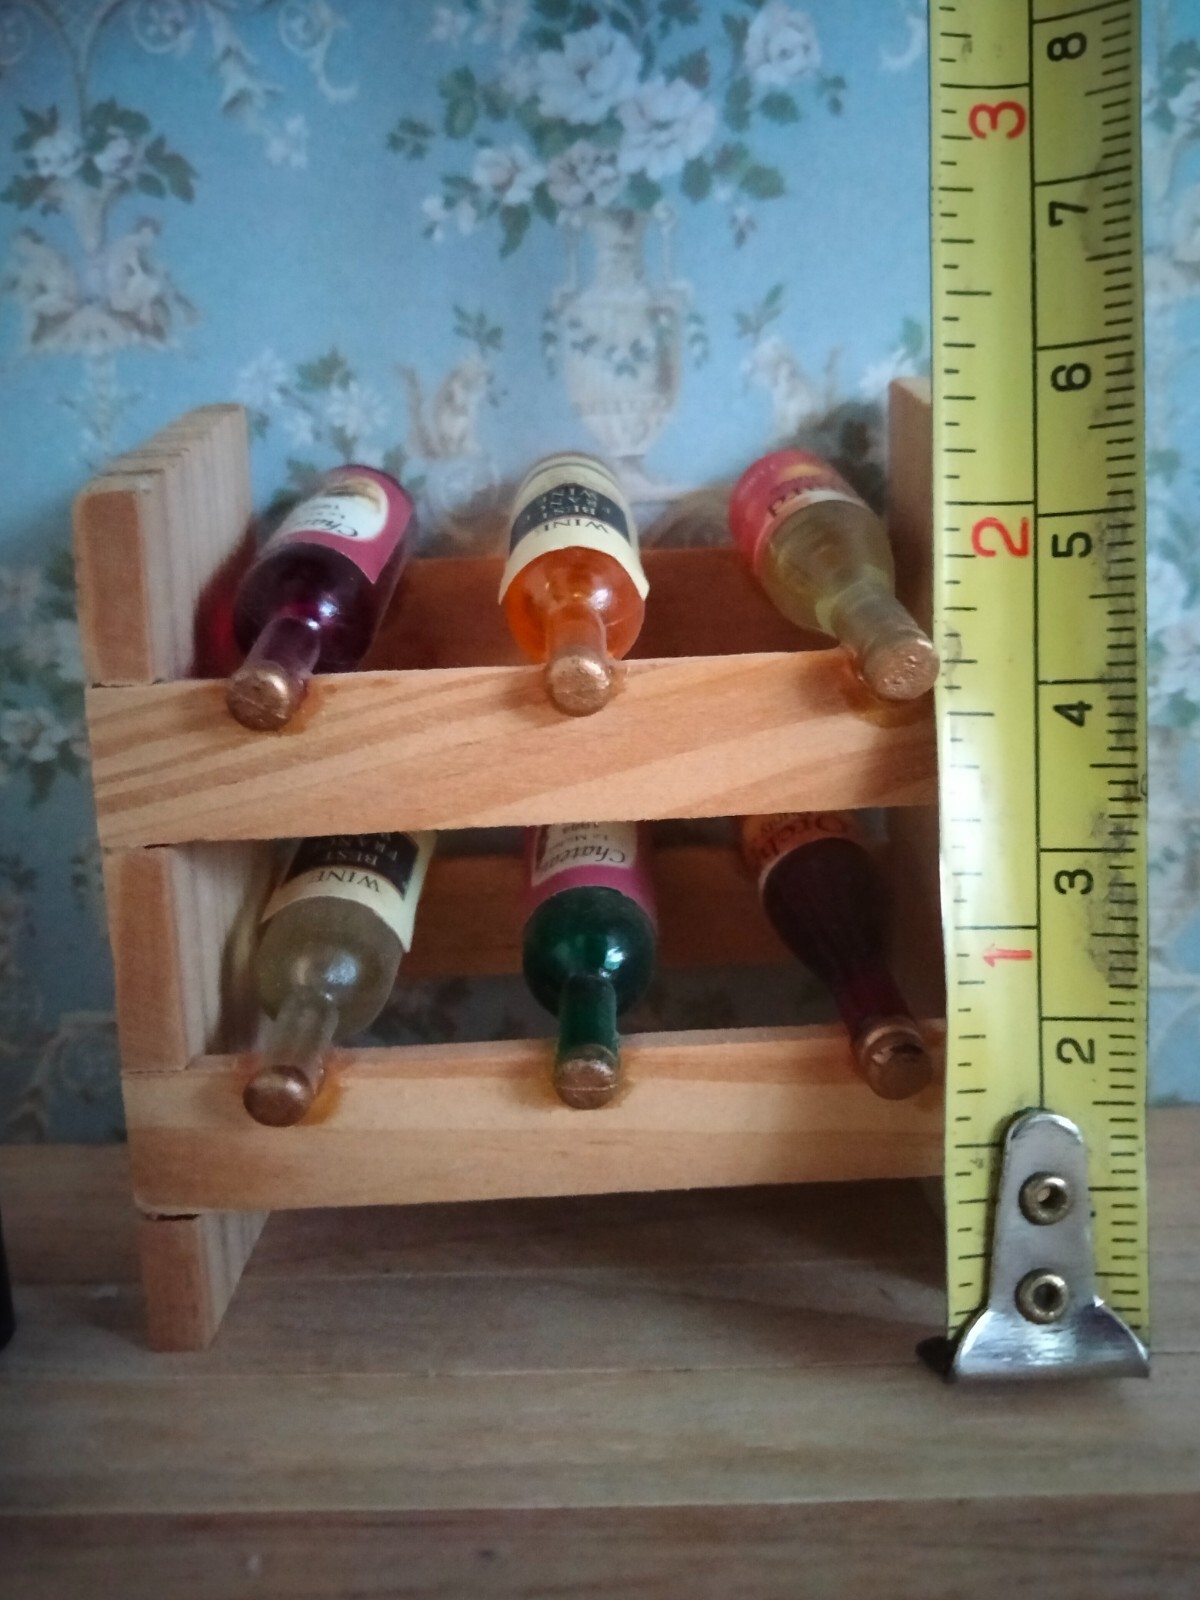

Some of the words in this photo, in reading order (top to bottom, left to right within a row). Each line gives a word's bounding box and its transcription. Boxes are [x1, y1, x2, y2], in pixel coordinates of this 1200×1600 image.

[1046, 31, 1088, 62] 8
[968, 100, 1027, 140] 3
[1048, 200, 1089, 228] 7
[1050, 362, 1092, 392] 6
[971, 516, 1030, 559] 2
[1051, 531, 1093, 558] 5
[1052, 700, 1093, 728] 4
[1053, 868, 1094, 896] 3
[983, 943, 1034, 968] 1
[1056, 1037, 1096, 1064] 2
